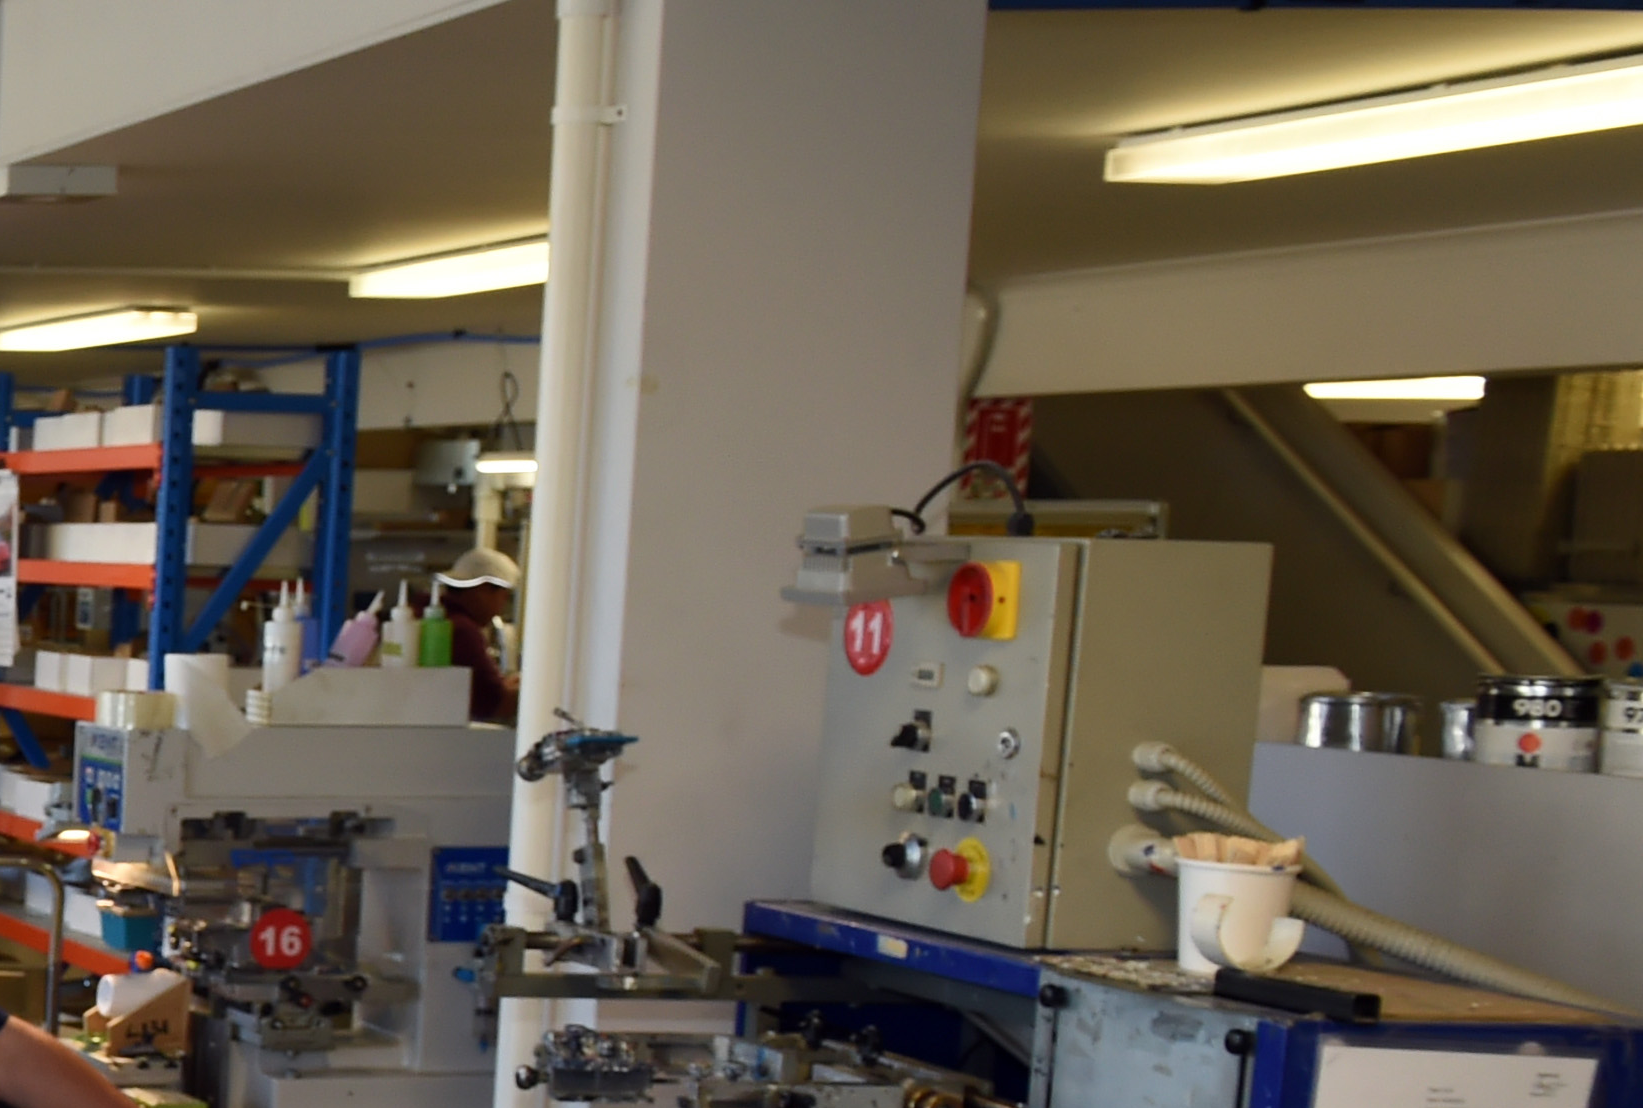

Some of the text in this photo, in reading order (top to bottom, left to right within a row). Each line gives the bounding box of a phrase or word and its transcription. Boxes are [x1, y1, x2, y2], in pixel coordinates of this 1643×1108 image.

[850, 611, 884, 655] 11
[1512, 699, 1563, 718] 980
[258, 925, 303, 957] 16
